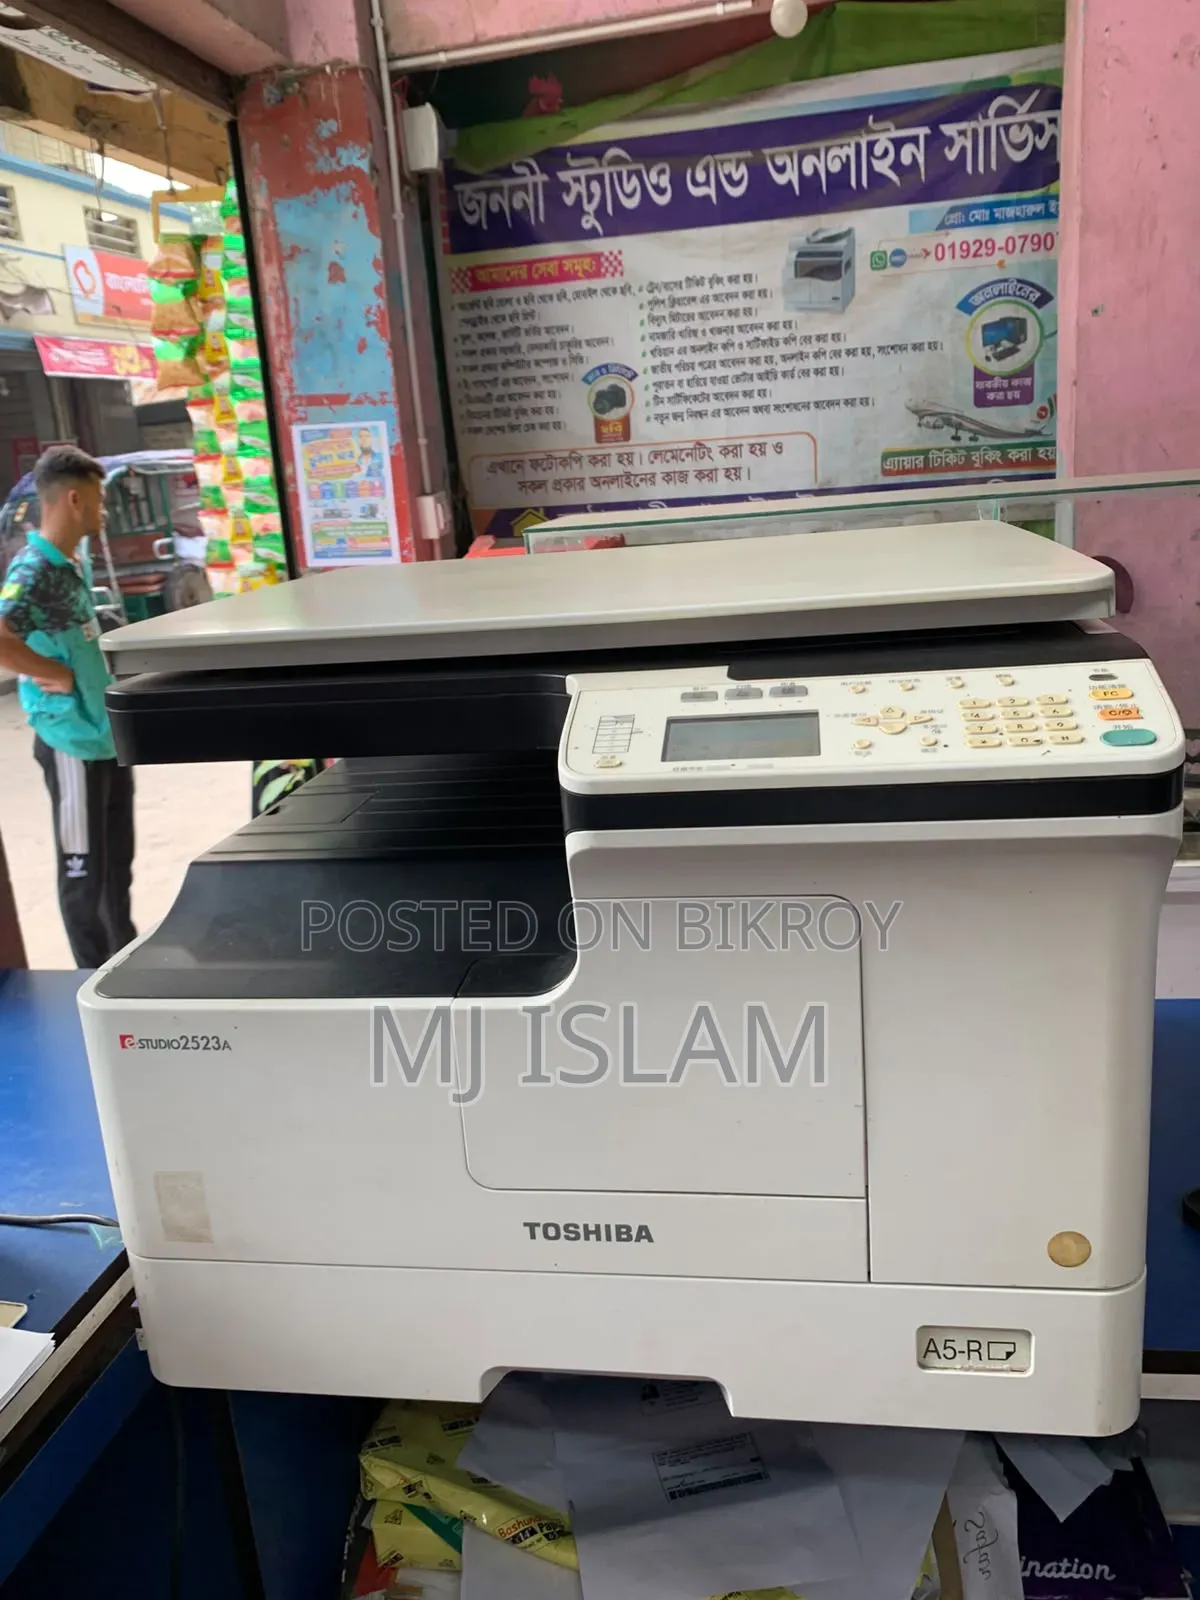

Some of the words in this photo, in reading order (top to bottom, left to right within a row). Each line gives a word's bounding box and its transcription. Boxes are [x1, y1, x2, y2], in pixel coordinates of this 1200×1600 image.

[453, 158, 549, 230] জননী
[557, 147, 672, 236] স্টুডিও
[686, 151, 753, 206] এন্ড
[762, 114, 931, 196] অনলাইন
[934, 231, 1060, 262] 01929-0790
[486, 457, 525, 476] এখানে
[529, 449, 584, 474] ফটোকপি
[587, 453, 612, 469] করা
[718, 444, 744, 461] করা
[747, 441, 767, 459] হয়
[772, 442, 784, 456] ও
[928, 451, 966, 469] টিকিট
[971, 451, 1002, 469] বুকিং
[1007, 448, 1033, 462] করা
[517, 478, 548, 496] সকল
[551, 476, 585, 494] প্রকার
[590, 470, 657, 491] অনলাইনের
[661, 470, 690, 486] কাজ
[693, 467, 719, 483] করা
[523, 1220, 655, 1244] TOSHIBA
[921, 1337, 984, 1362] A5-R
